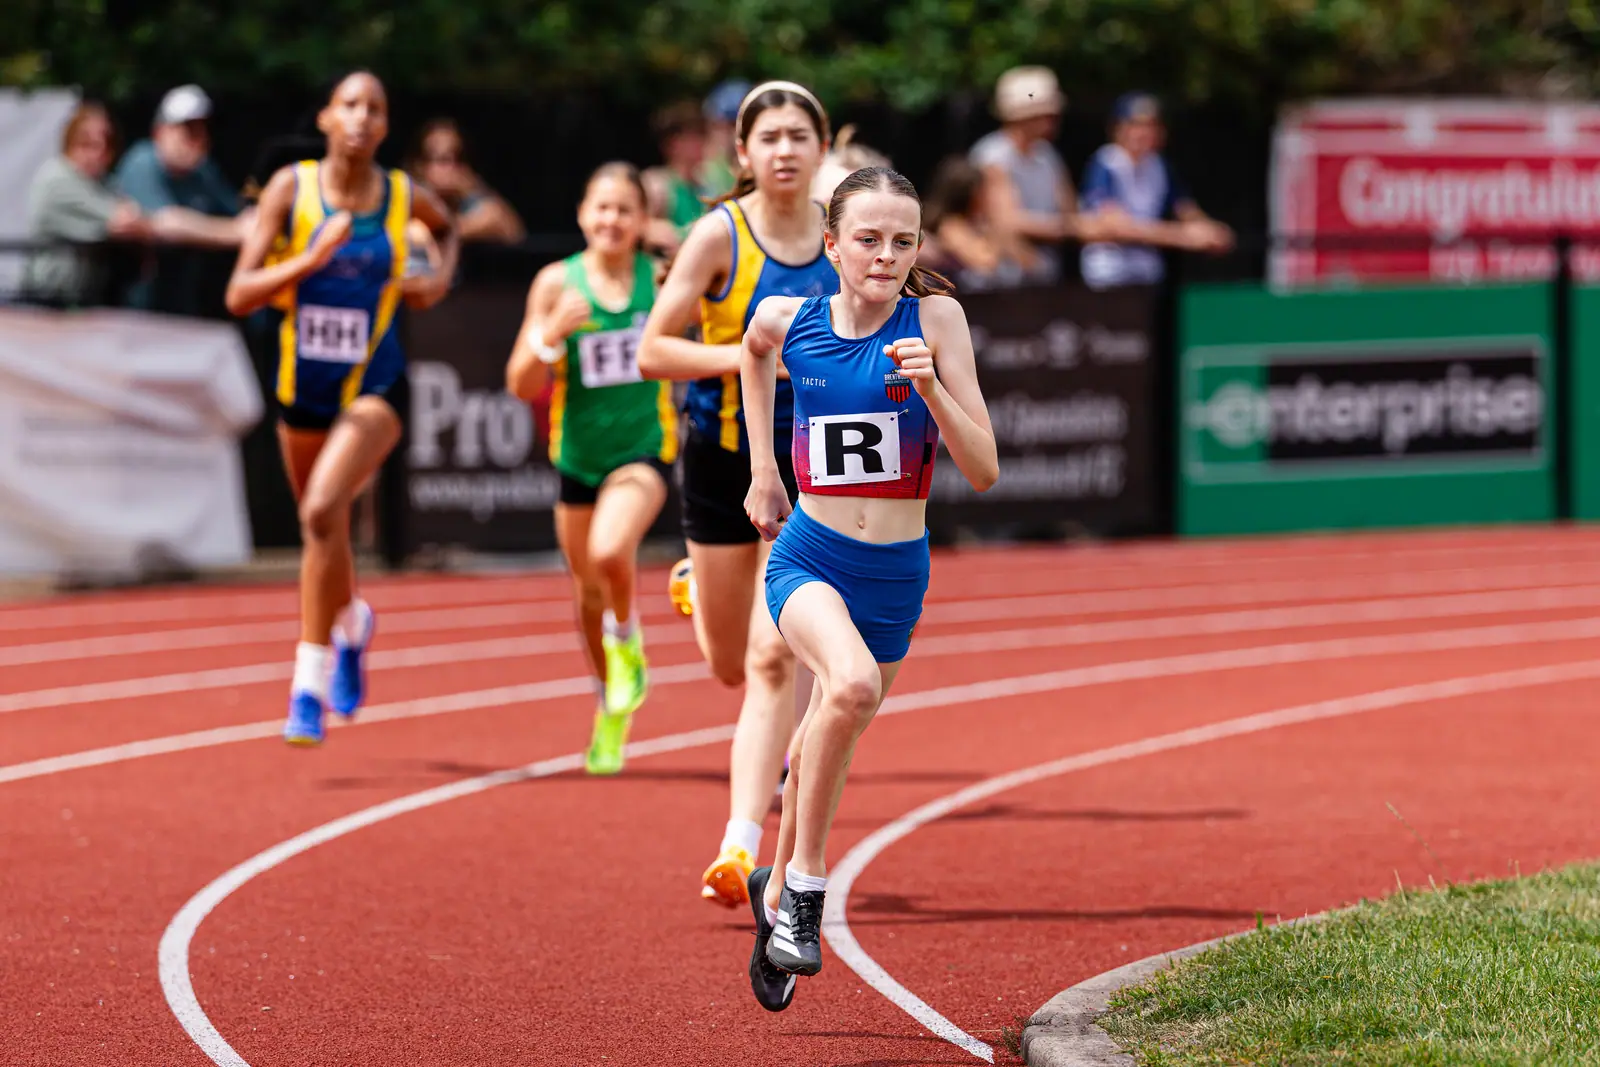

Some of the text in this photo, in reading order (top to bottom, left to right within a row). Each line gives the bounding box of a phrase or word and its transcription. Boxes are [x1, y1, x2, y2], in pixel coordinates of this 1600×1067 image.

[305, 316, 360, 350] HH
[802, 377, 826, 387] TACTIC
[1190, 362, 1546, 454] enterprise
[407, 361, 533, 468] Pro
[824, 421, 886, 477] R
